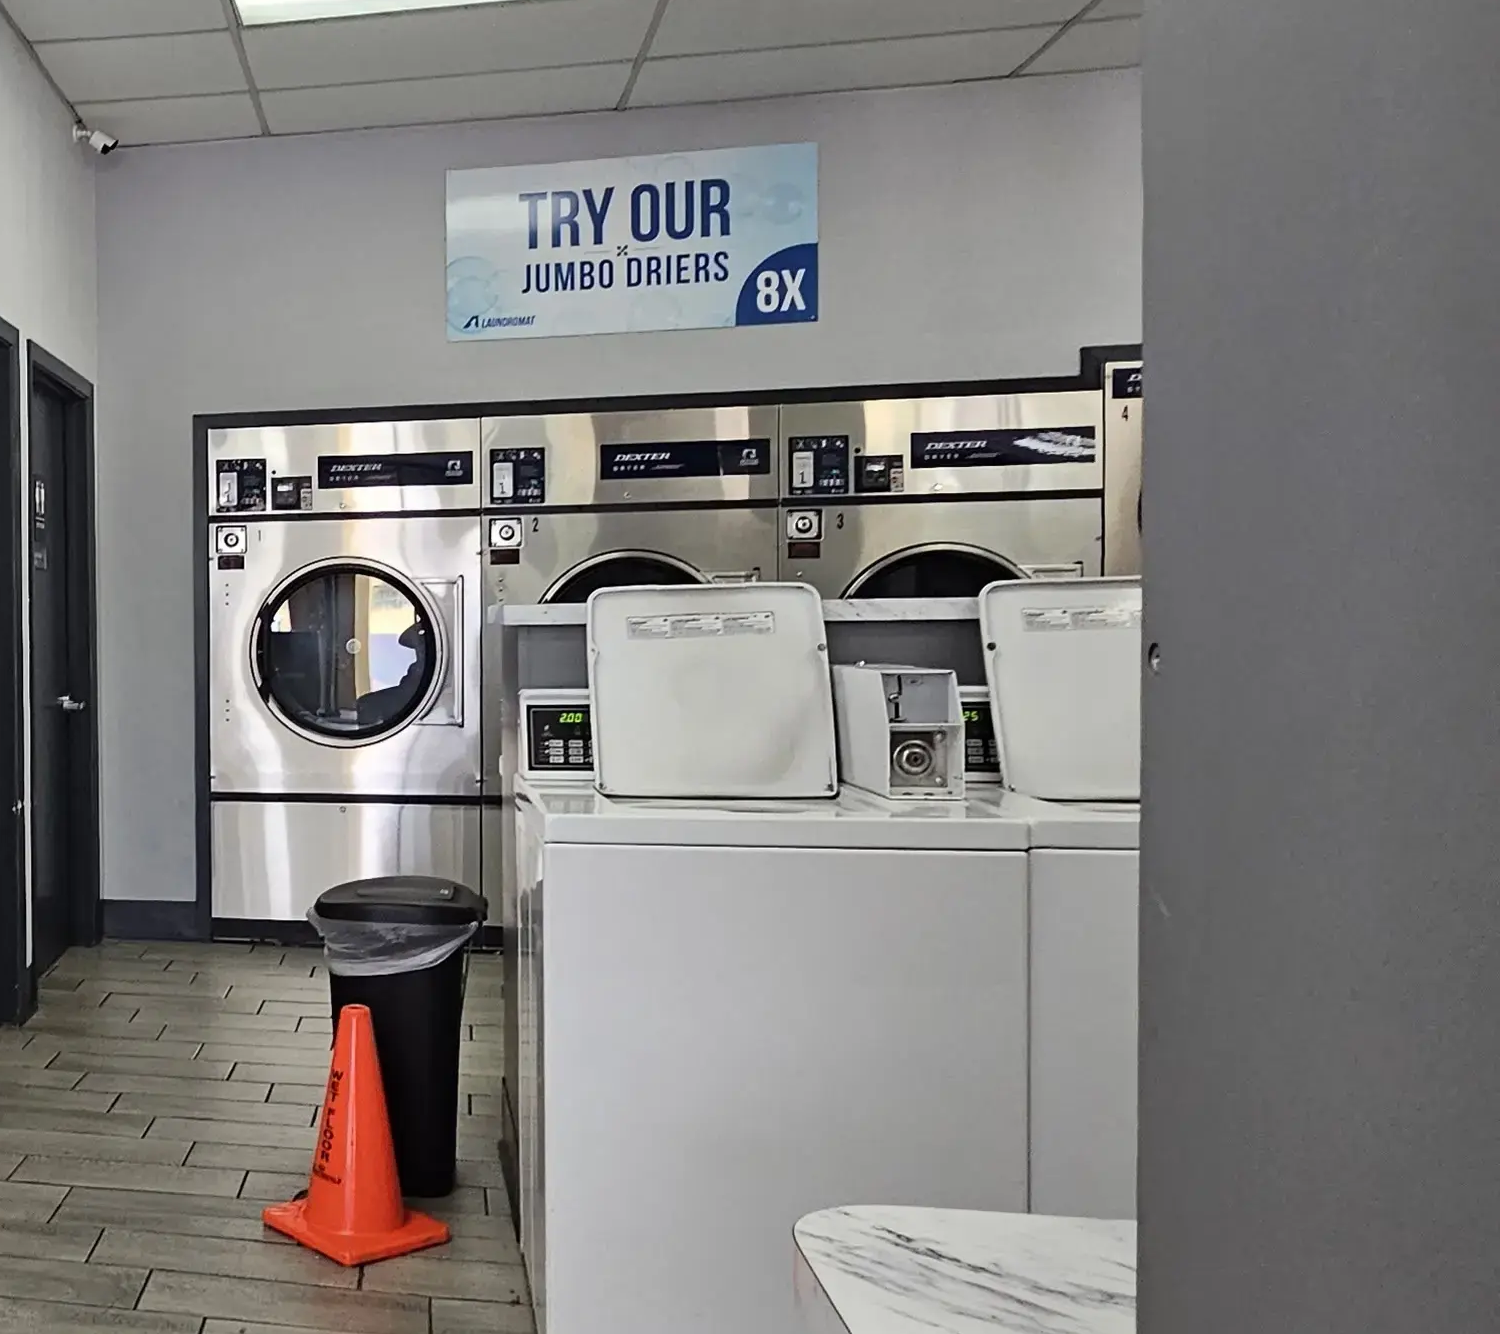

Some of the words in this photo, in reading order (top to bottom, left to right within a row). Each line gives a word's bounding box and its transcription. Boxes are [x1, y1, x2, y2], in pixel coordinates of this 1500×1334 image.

[518, 186, 615, 250] TRY
[631, 178, 731, 243] OUR
[521, 259, 614, 294] JUMBO
[626, 251, 729, 287] DRIERS
[756, 267, 806, 313] 8X
[1121, 405, 1128, 421] 4
[924, 440, 987, 451] DEXTER
[613, 452, 671, 462] DEXTER
[532, 517, 539, 532] 2
[836, 513, 844, 530] 3
